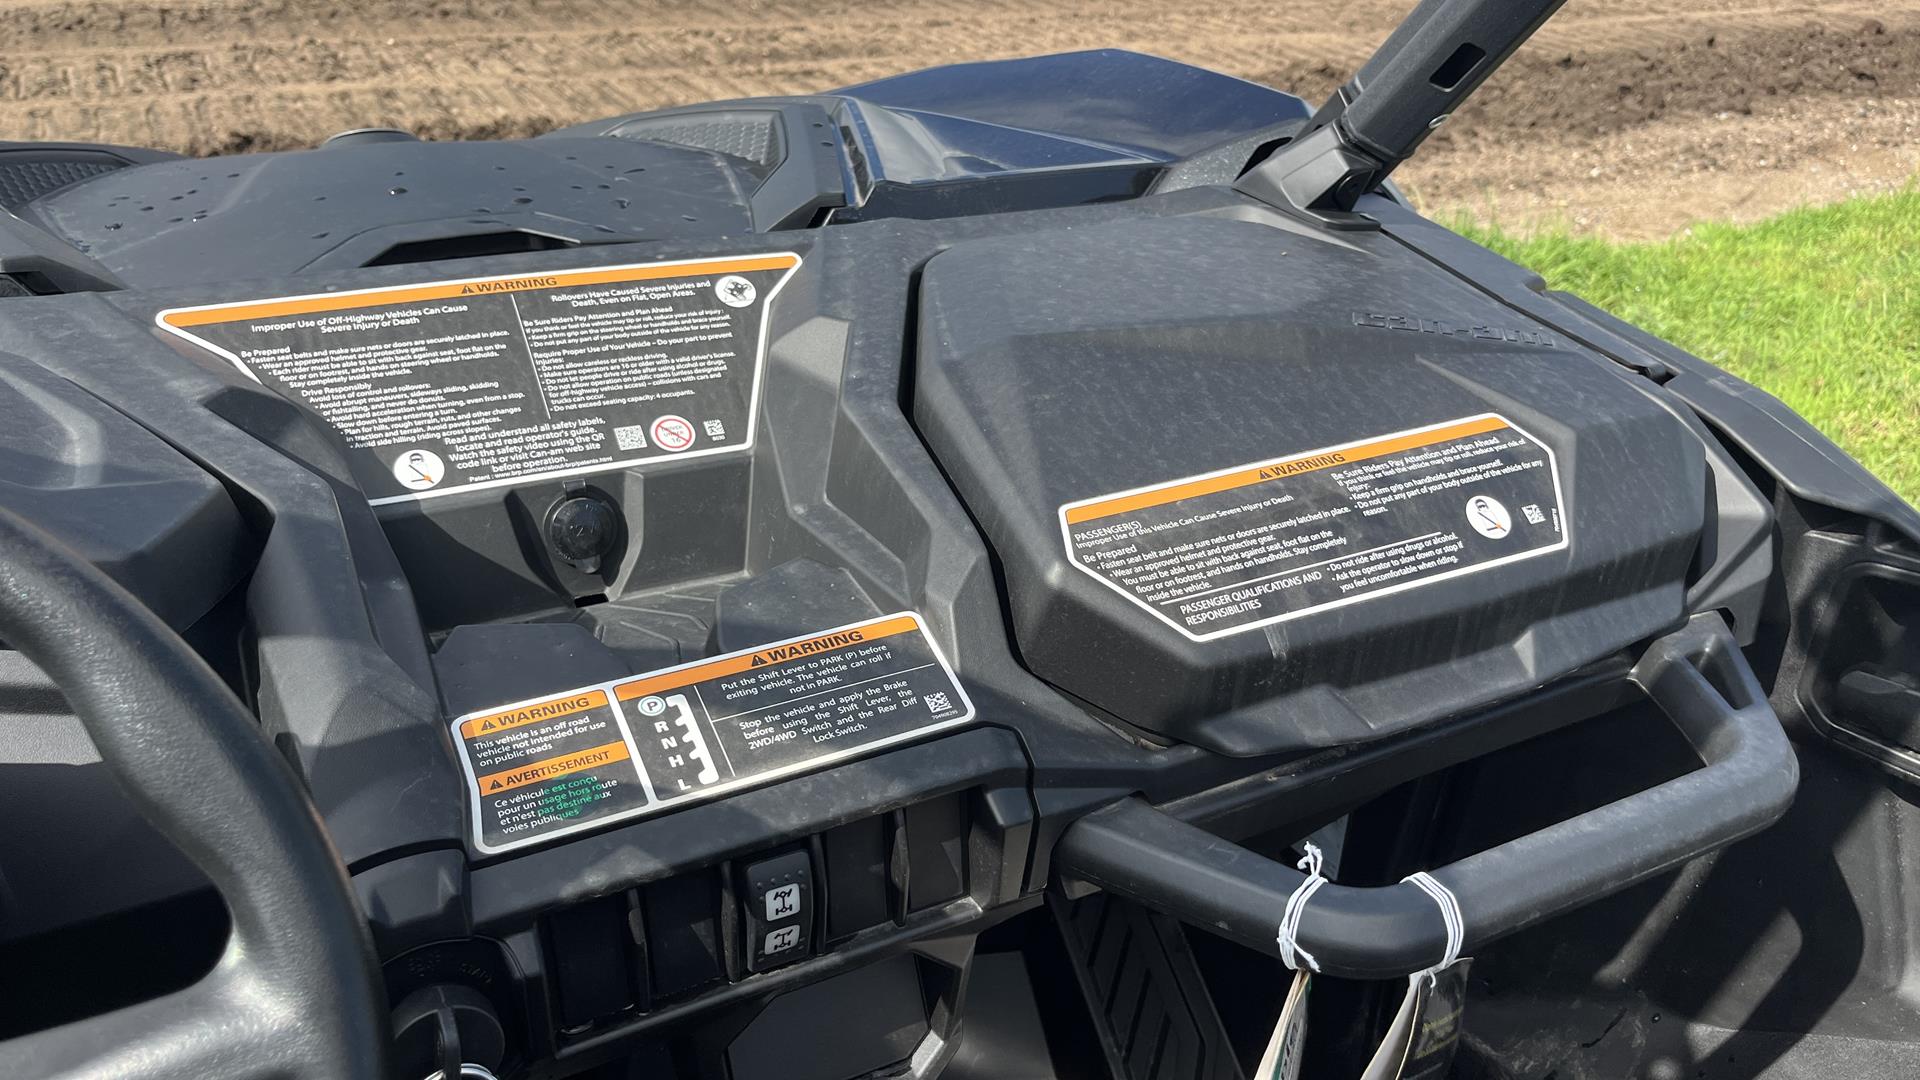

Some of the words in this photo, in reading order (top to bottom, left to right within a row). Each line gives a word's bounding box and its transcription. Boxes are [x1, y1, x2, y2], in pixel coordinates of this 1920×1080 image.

[476, 277, 556, 292] WARNING
[550, 293, 588, 302] Rollovers
[588, 290, 610, 298] Have
[609, 286, 640, 296] Caused
[639, 285, 666, 294] Severe
[666, 282, 695, 292] Injuries
[695, 279, 711, 288] and
[648, 291, 671, 300] Open
[251, 322, 296, 333] Improper
[297, 320, 315, 328] Use
[316, 317, 327, 326] of
[327, 313, 385, 325] Off-Highway
[385, 309, 422, 319] Vehicles
[422, 307, 441, 315] Can
[441, 304, 468, 313] Cause
[320, 324, 352, 333] Severe
[352, 321, 380, 331] Injury
[392, 316, 420, 326] Death
[443, 434, 468, 445] Read
[468, 431, 487, 442] and
[487, 424, 538, 439] understand
[539, 422, 550, 432] all
[551, 420, 577, 431] safety
[455, 442, 483, 452] locate
[484, 438, 502, 448] and
[503, 435, 524, 445] read
[524, 429, 569, 444] operator's
[448, 450, 478, 462] Watch
[478, 448, 495, 457] the
[496, 444, 523, 455] safety
[523, 441, 549, 450] video
[550, 438, 575, 447] using
[574, 435, 590, 443] the
[590, 432, 605, 442] QR
[456, 459, 480, 469] code
[480, 456, 498, 466] link
[498, 455, 509, 463] or
[509, 451, 529, 461] visit
[529, 447, 564, 458] Can-am
[564, 444, 584, 453] web
[584, 442, 601, 450] site
[1330, 472, 1345, 480] Be
[1342, 467, 1364, 478] Sure
[1362, 462, 1390, 474] Riders
[1387, 458, 1404, 469] Pay
[1404, 451, 1442, 464] Attention
[1440, 445, 1458, 455] and
[1455, 443, 1475, 452] Plan
[1473, 436, 1500, 448] Ahead
[1270, 453, 1345, 476] WARNING
[1074, 520, 1142, 542] PASSENGER(S)
[1329, 563, 1342, 571] Do
[1341, 558, 1355, 568] not
[1354, 555, 1369, 565] ride
[1368, 551, 1385, 561] after
[1385, 546, 1406, 557] using
[1404, 541, 1425, 552] drugs
[1423, 539, 1432, 547] or
[1179, 593, 1232, 614] PASSENGER
[1231, 575, 1302, 601] QUALIFICATIONS
[1302, 570, 1322, 583] AND
[1185, 598, 1261, 626] RESPONSIBILITIES
[768, 630, 863, 662] WARNING
[721, 681, 738, 691] Put
[739, 677, 756, 686] the
[757, 670, 780, 682] Shift
[781, 664, 805, 676] Lever
[819, 654, 843, 666] PARK
[844, 650, 857, 660] (P)
[858, 645, 887, 656] before
[726, 687, 758, 700] exiting
[760, 678, 795, 691] vehicle.
[797, 673, 814, 681] The
[816, 664, 847, 676] vehicle
[850, 659, 866, 668] can
[868, 654, 883, 663] roll
[884, 651, 891, 659] if
[789, 684, 806, 694] not
[816, 674, 842, 687] PARK.
[498, 697, 589, 726] WARNING
[647, 701, 659, 712] P
[738, 719, 762, 730] Stop
[764, 714, 780, 723] the
[783, 704, 815, 718] vehicle
[818, 697, 836, 709] and
[838, 691, 862, 704] apply
[865, 687, 881, 696] the
[883, 680, 907, 691] Brake
[743, 726, 774, 740] before
[782, 717, 808, 729] using
[814, 711, 830, 720] the
[837, 702, 859, 714] Shift
[865, 695, 891, 706] Lever,
[897, 689, 912, 698] the
[473, 740, 494, 750] This
[495, 731, 529, 745] vehicle
[539, 726, 552, 734] an
[553, 720, 566, 731] off
[567, 715, 590, 727] road
[654, 720, 670, 734] R
[748, 730, 797, 750] 2WD/4WD
[801, 721, 832, 735] Switch
[836, 714, 854, 725] and
[857, 710, 874, 719] the
[877, 703, 897, 714] Rear
[901, 696, 917, 707] Diff
[812, 731, 835, 743] Lock
[834, 722, 867, 737] Switch.
[476, 744, 510, 758] vehicle
[512, 739, 529, 750] not
[529, 727, 573, 745] intended
[573, 725, 587, 734] for
[589, 721, 606, 730] use
[660, 737, 679, 750] N
[479, 758, 493, 767] on
[494, 750, 525, 764] public
[525, 742, 552, 755] roads
[506, 750, 608, 786] AVERTISSEMENT
[668, 755, 685, 768] H
[494, 799, 508, 808] Ce
[509, 788, 549, 804] véhicule
[551, 783, 566, 792] est
[568, 775, 597, 788] conçu
[497, 805, 520, 818] pour
[522, 801, 536, 810] un
[537, 793, 567, 806] usage
[567, 787, 590, 798] hors
[592, 779, 617, 791] route
[678, 779, 692, 792] L
[500, 816, 511, 825] et
[512, 810, 536, 822] n'est
[536, 805, 554, 818] pas
[556, 794, 592, 810] destiné
[594, 790, 611, 800] aux
[502, 822, 528, 834] voies
[530, 809, 579, 829] publiques
